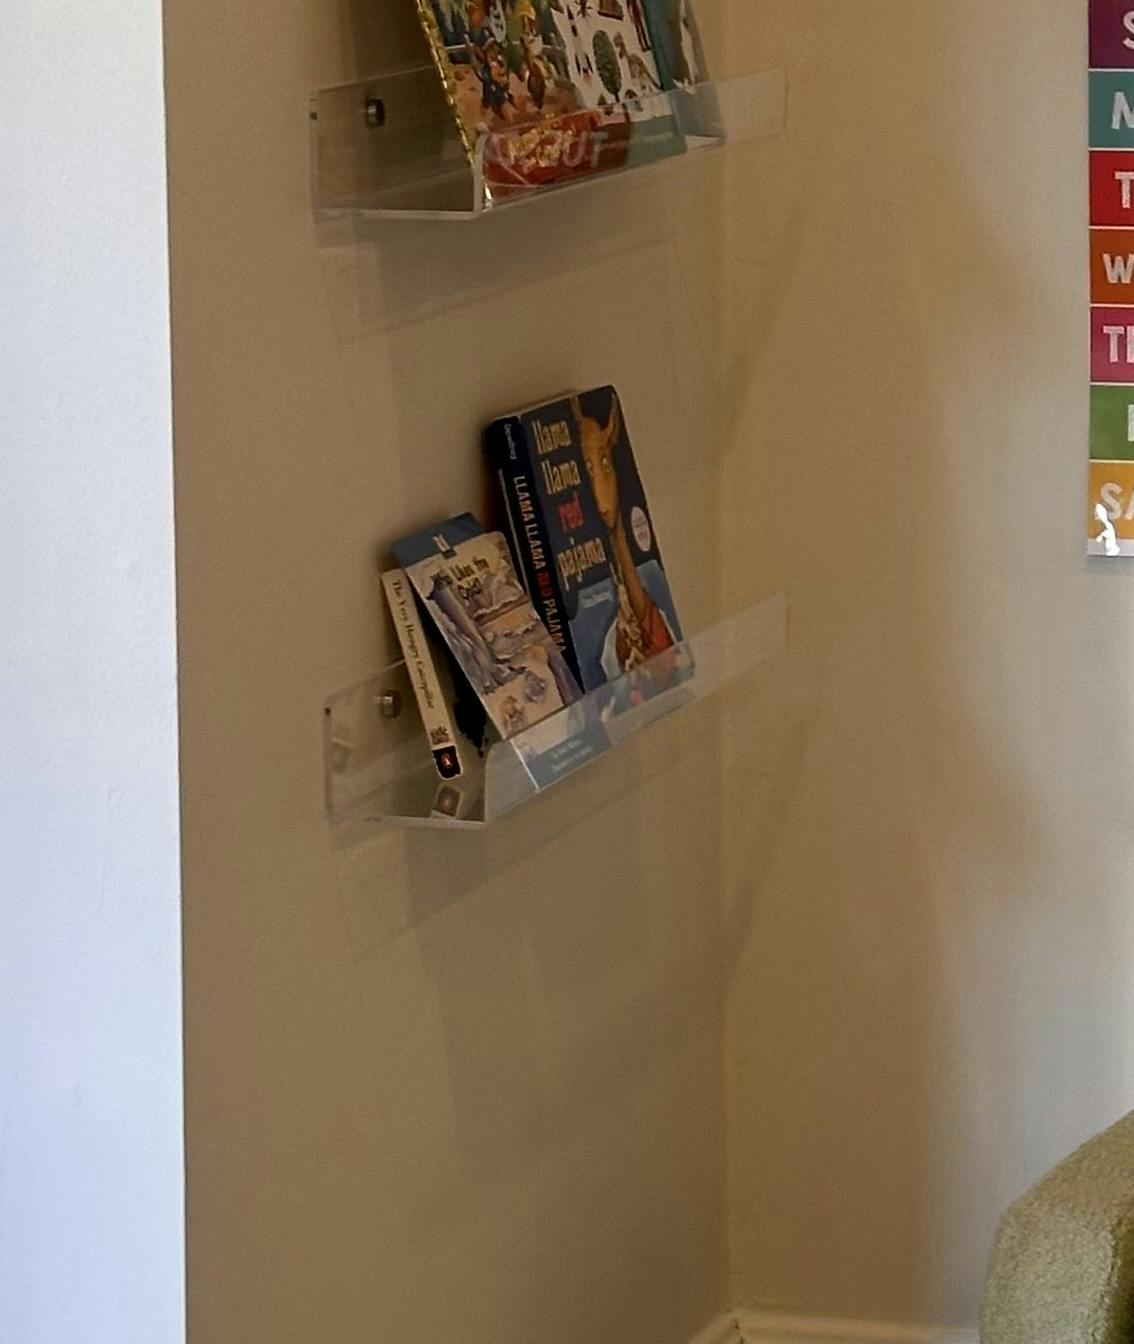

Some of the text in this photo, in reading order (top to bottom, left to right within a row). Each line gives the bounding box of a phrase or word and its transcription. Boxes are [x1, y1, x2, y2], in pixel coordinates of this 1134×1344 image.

[534, 421, 572, 454] llama
[541, 459, 581, 495] llama
[558, 492, 584, 532] red
[558, 537, 606, 591] pajama
